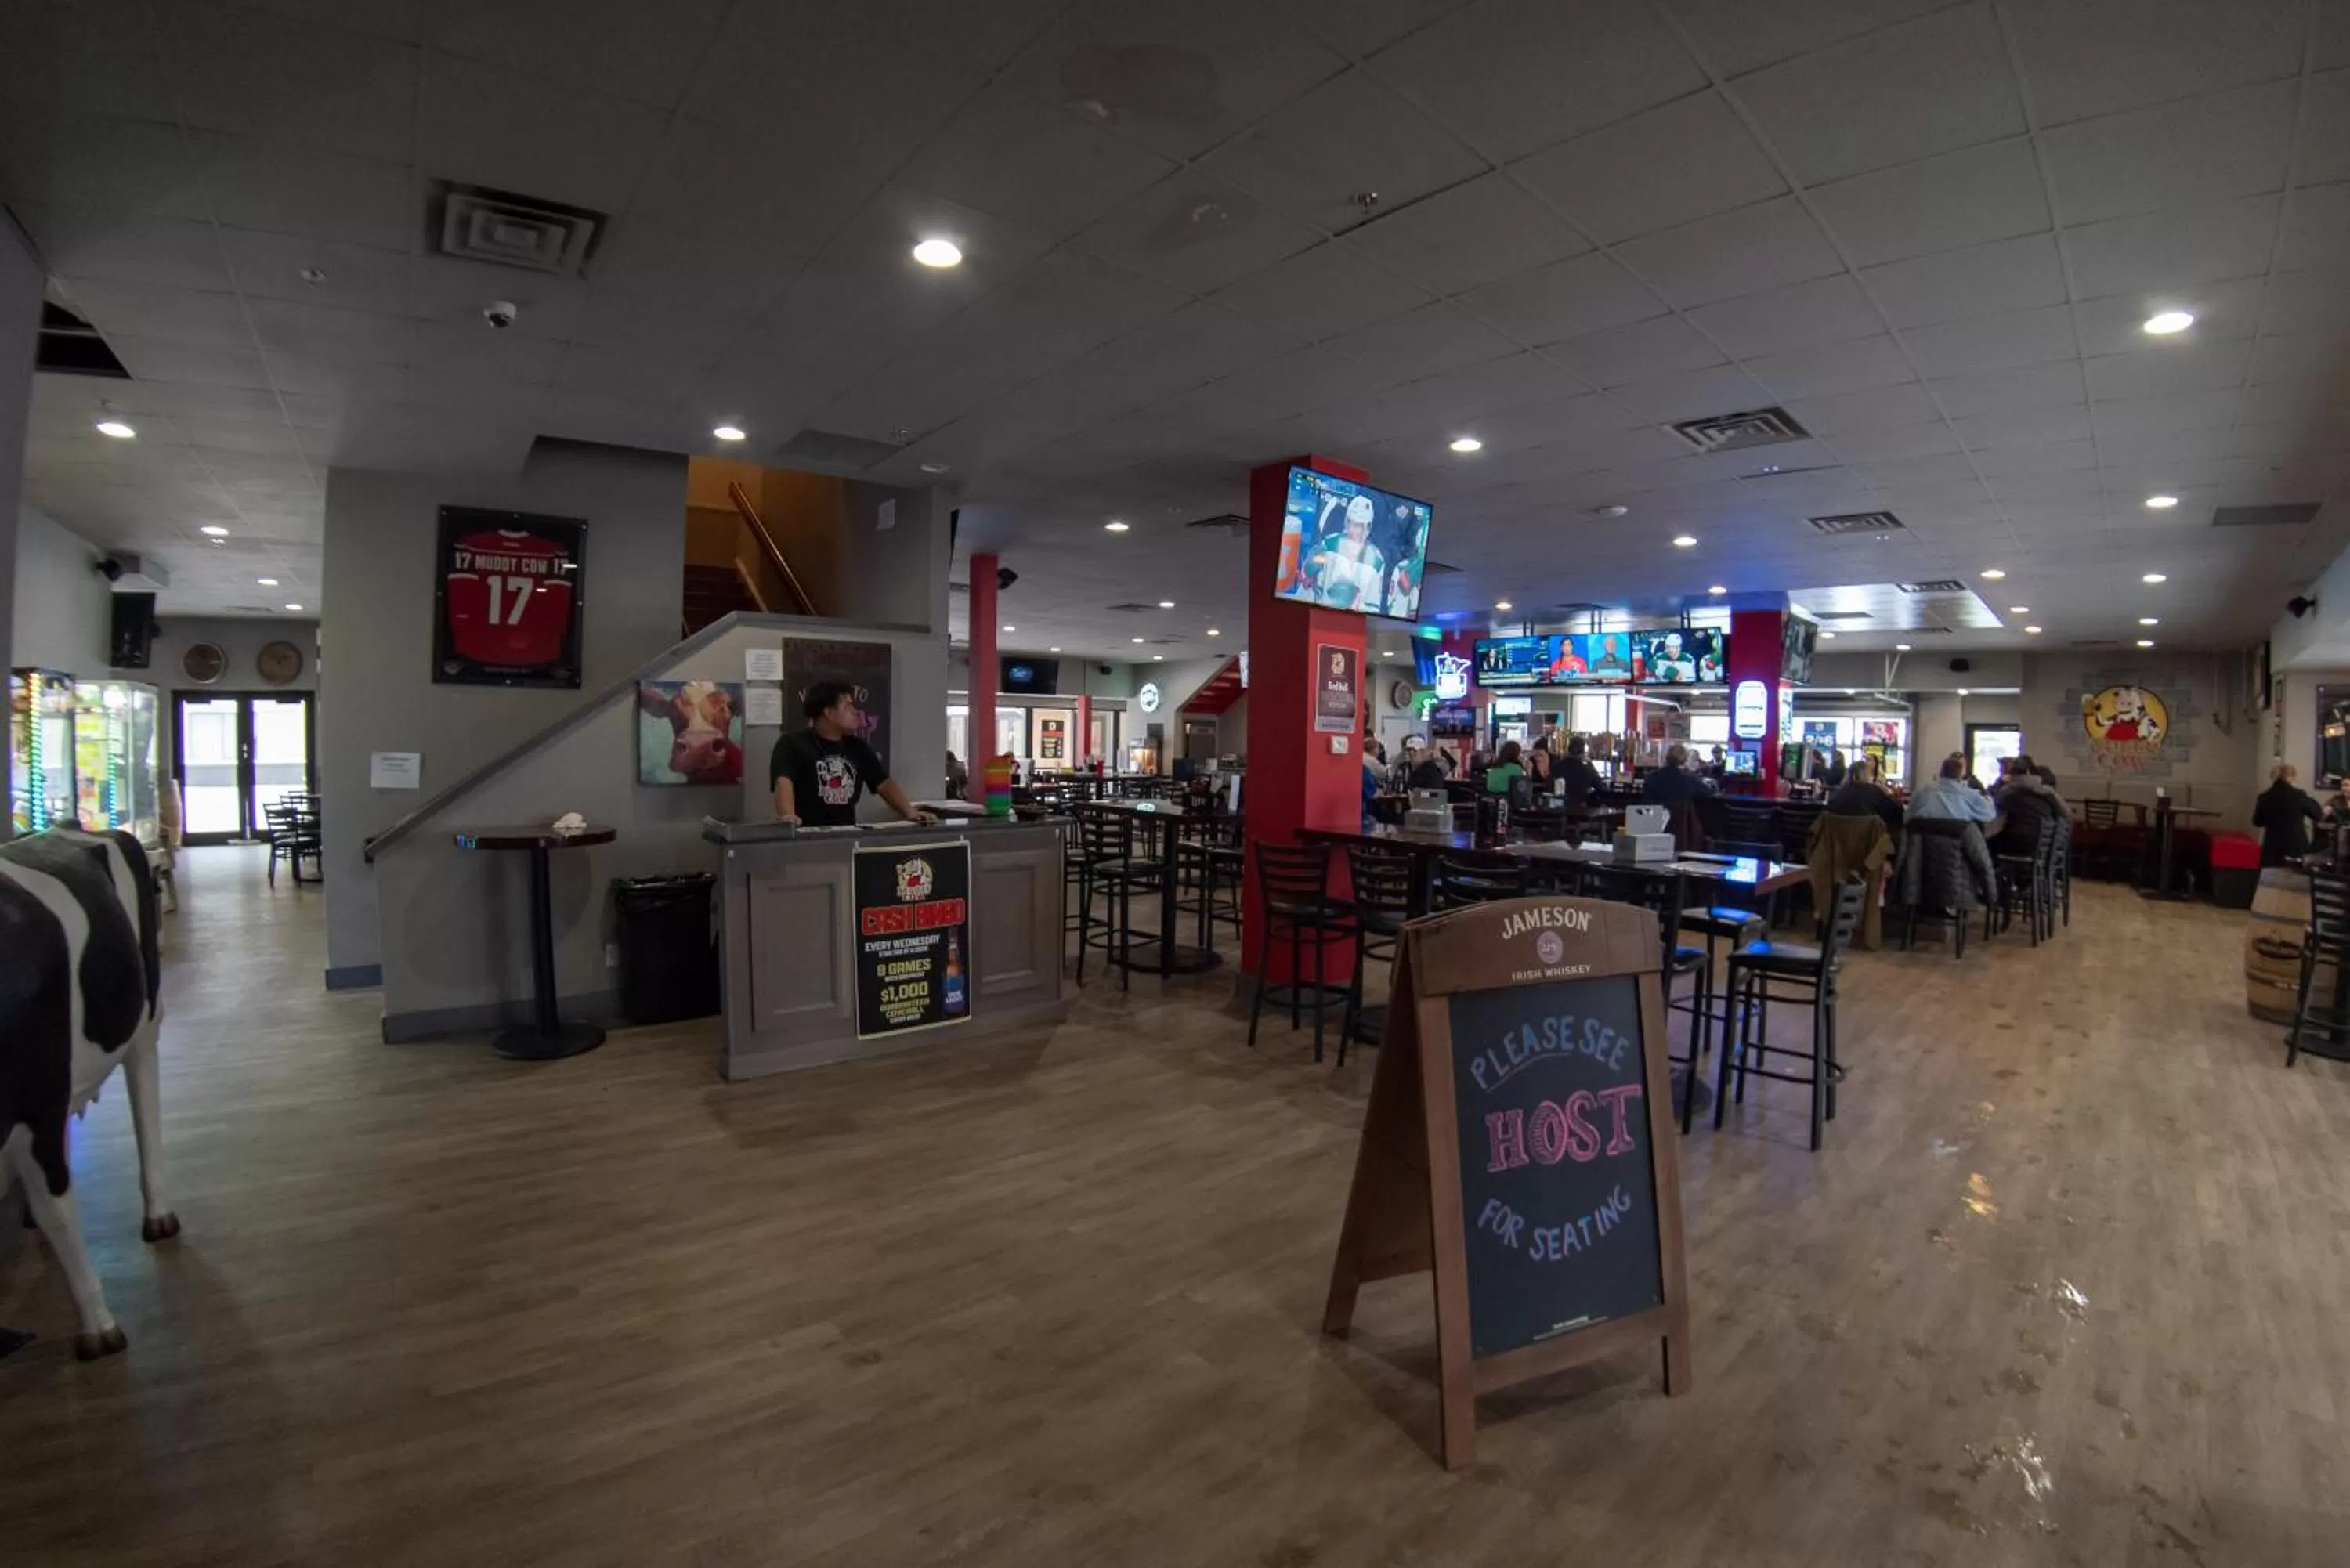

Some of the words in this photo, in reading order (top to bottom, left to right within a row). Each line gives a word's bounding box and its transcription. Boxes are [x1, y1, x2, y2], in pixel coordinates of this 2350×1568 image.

[455, 551, 472, 570] 17
[475, 555, 517, 572] MUDDY
[522, 558, 548, 573] COW
[486, 576, 534, 626] 17
[862, 905, 913, 935] CASH
[1502, 906, 1590, 940] JAMESON
[864, 941, 891, 952] EVERY
[892, 934, 940, 949] WEDNESDAY
[888, 958, 931, 976] GAMES
[1511, 970, 1542, 982] IRISH
[1544, 964, 1592, 978] WHISKEY
[880, 981, 929, 1003] $1,000
[1470, 1014, 1575, 1090] PLEASE
[1578, 1017, 1630, 1072] SEE
[1484, 1084, 1642, 1173] HOST
[1477, 1197, 1525, 1249] FOR
[1530, 1184, 1632, 1262] SEATING
